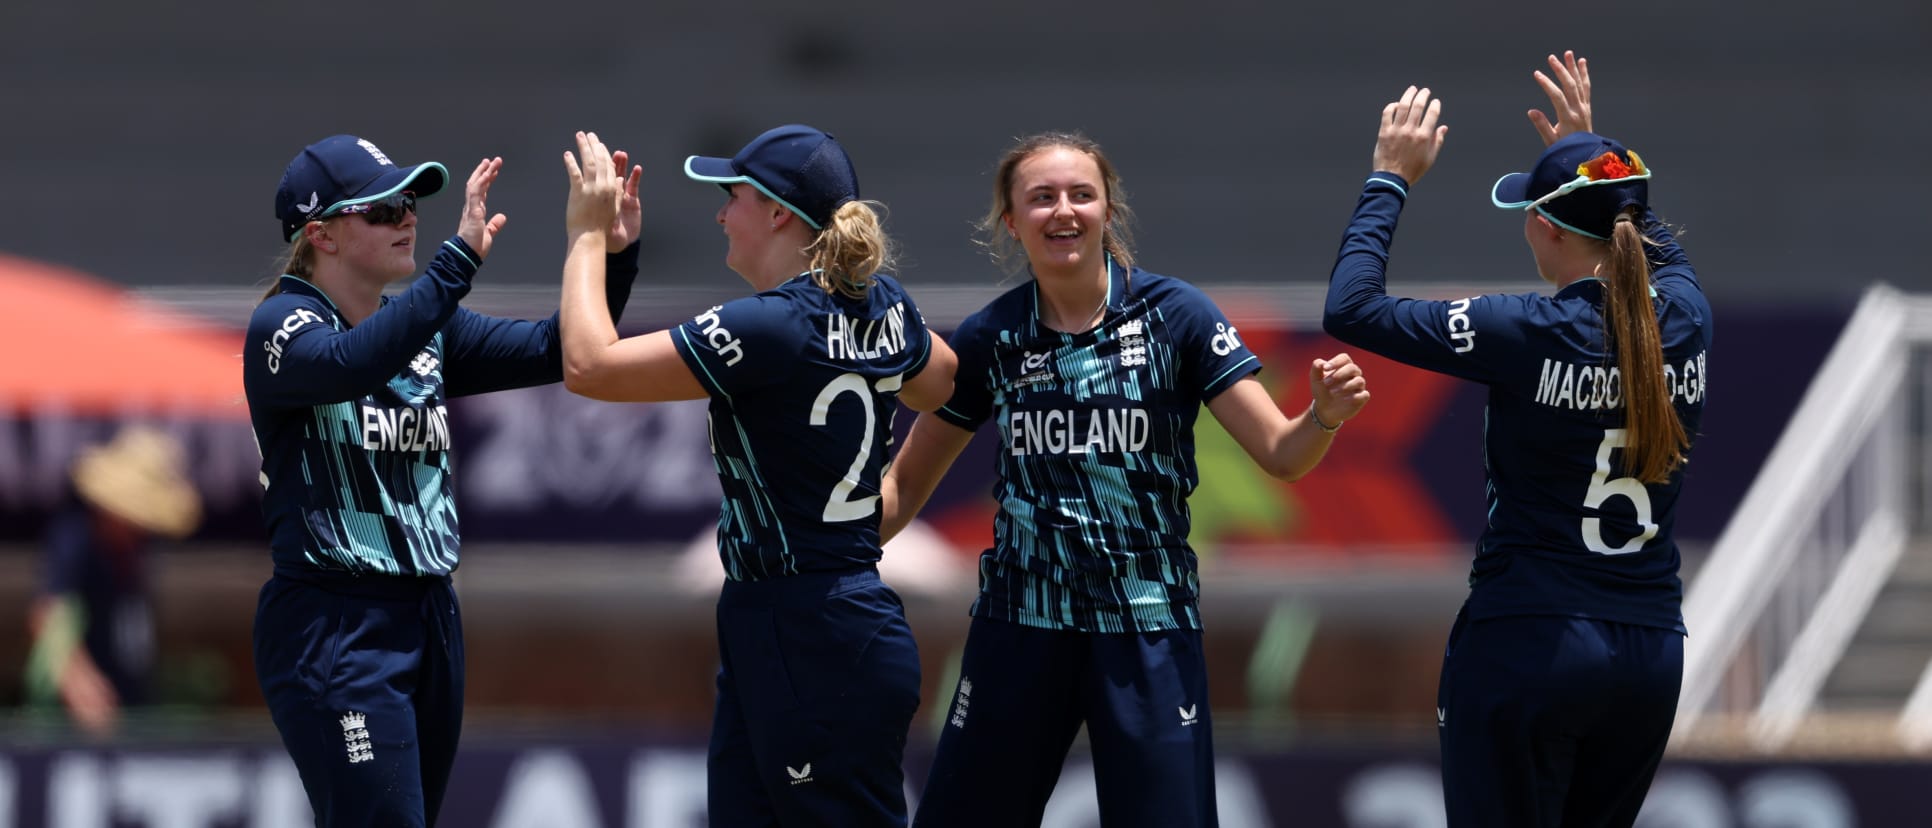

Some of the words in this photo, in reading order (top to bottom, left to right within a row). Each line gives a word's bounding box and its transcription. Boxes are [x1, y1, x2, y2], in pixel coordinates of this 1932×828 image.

[264, 308, 324, 374] cinch
[1448, 295, 1476, 353] nch
[1011, 408, 1149, 457] ENGLAND
[1581, 429, 1659, 555] 5
